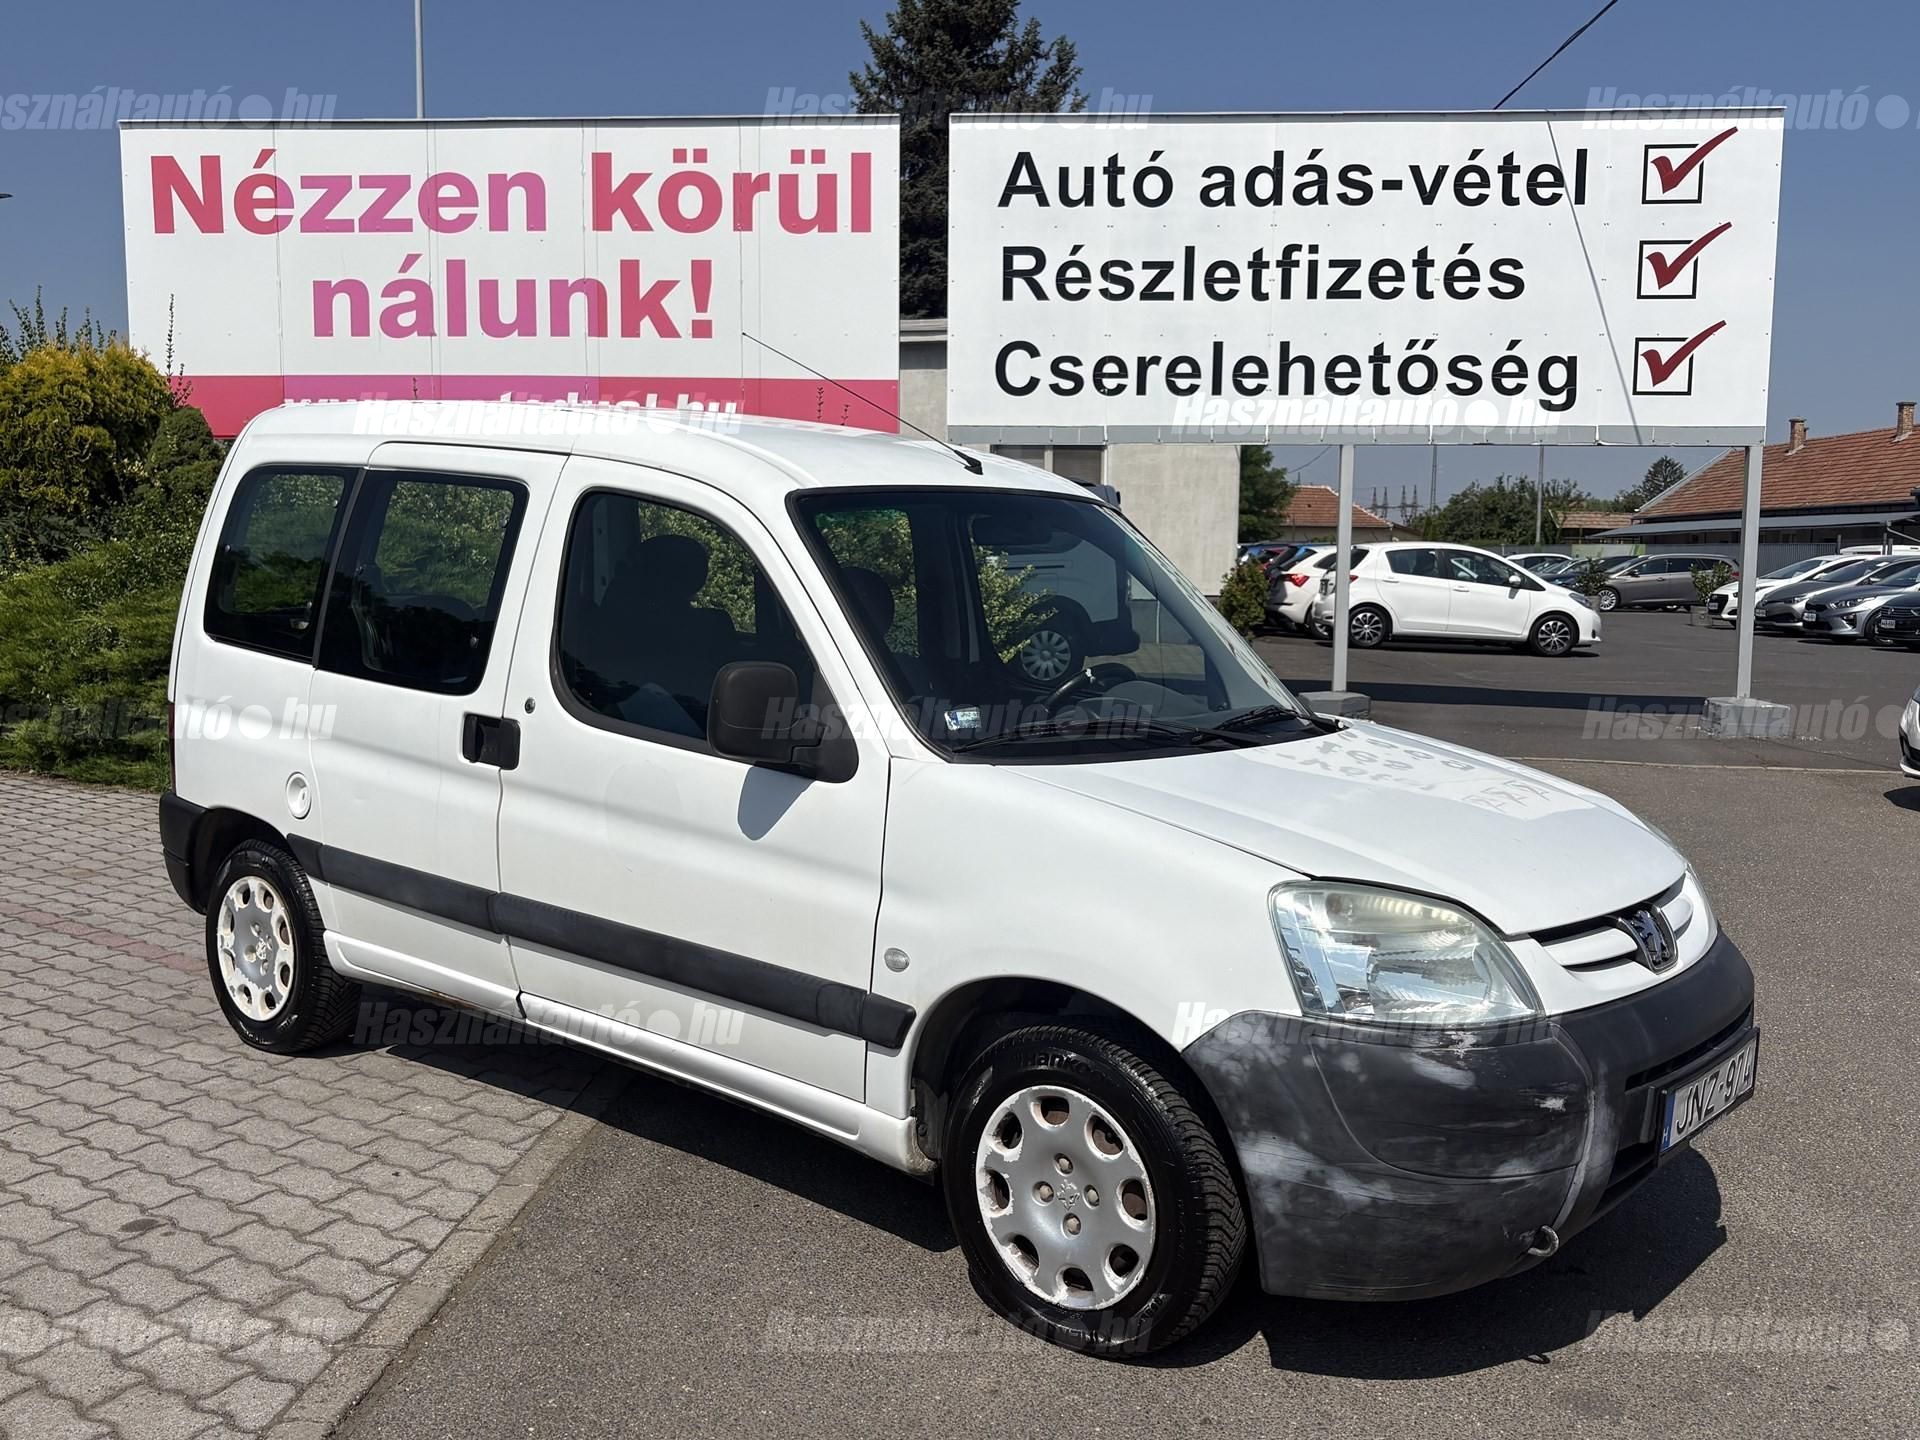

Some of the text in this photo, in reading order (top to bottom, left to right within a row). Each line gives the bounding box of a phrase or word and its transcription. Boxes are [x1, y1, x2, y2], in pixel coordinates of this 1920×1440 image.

[152, 149, 871, 234] Nézzen körül
[1000, 149, 1587, 207] Autó adás-vétel
[314, 255, 712, 338] nálunk!
[1003, 244, 1524, 301] Részletfizetés
[996, 339, 1577, 411] Cserelehetőség
